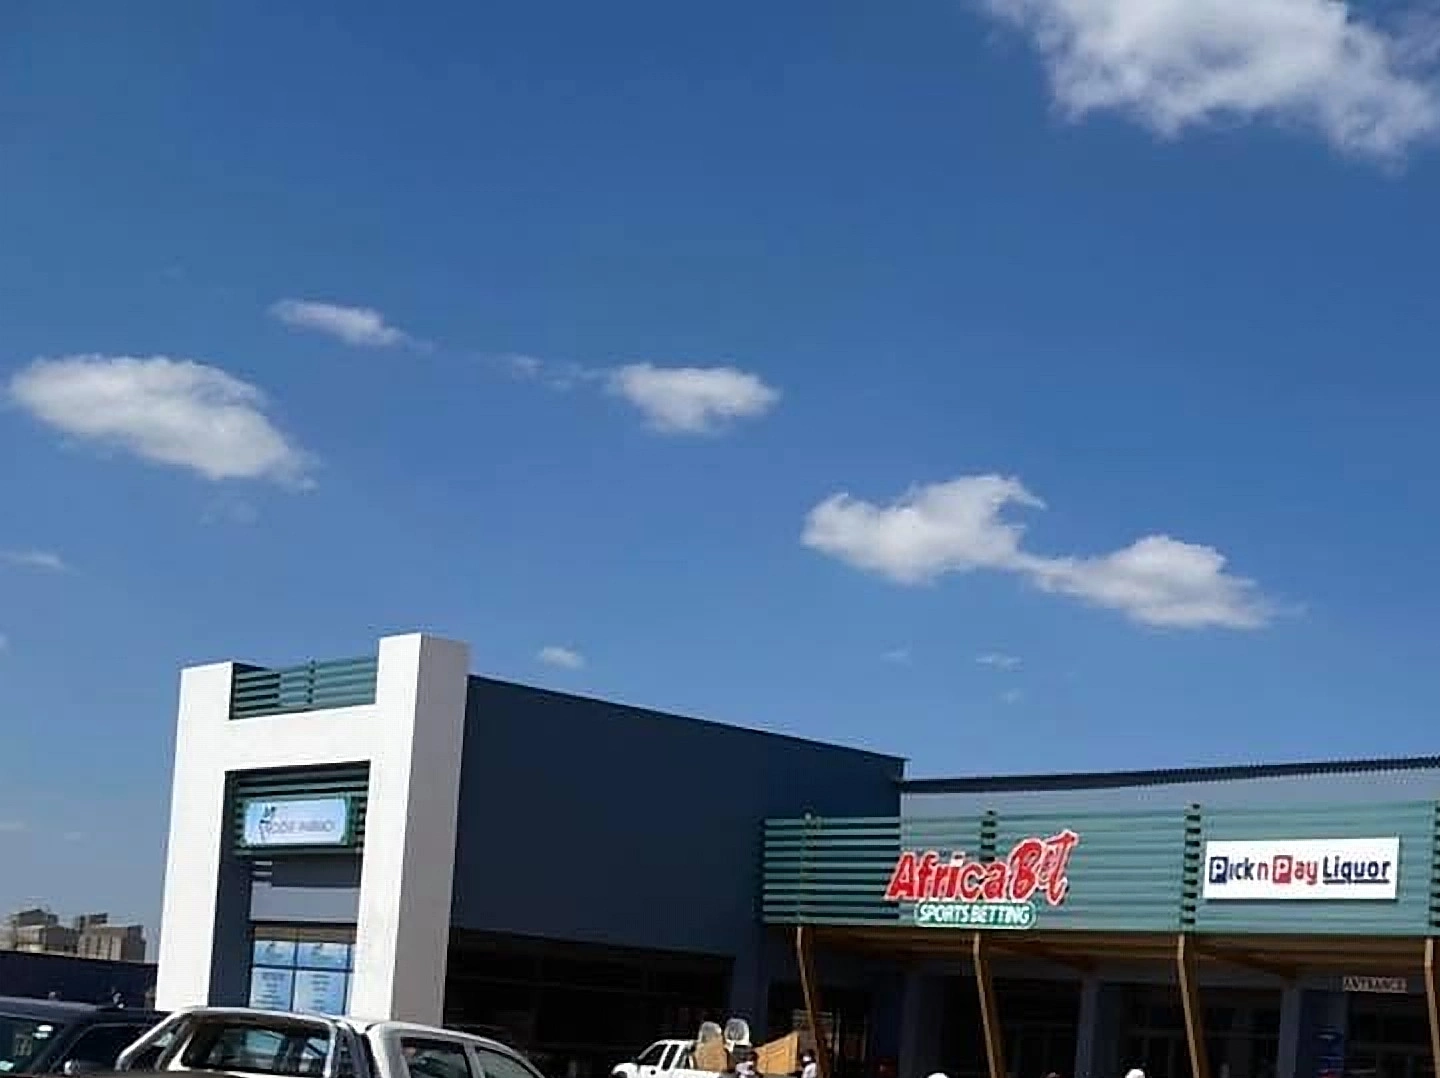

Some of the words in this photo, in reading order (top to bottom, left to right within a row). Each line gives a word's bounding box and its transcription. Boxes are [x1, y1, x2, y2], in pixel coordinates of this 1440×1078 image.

[1208, 856, 1255, 884] Pick
[1257, 862, 1269, 881] n
[1272, 855, 1318, 885] Pay
[1322, 855, 1392, 885] Liquor
[918, 903, 969, 922] SPORTS
[970, 904, 1031, 924] BETTING
